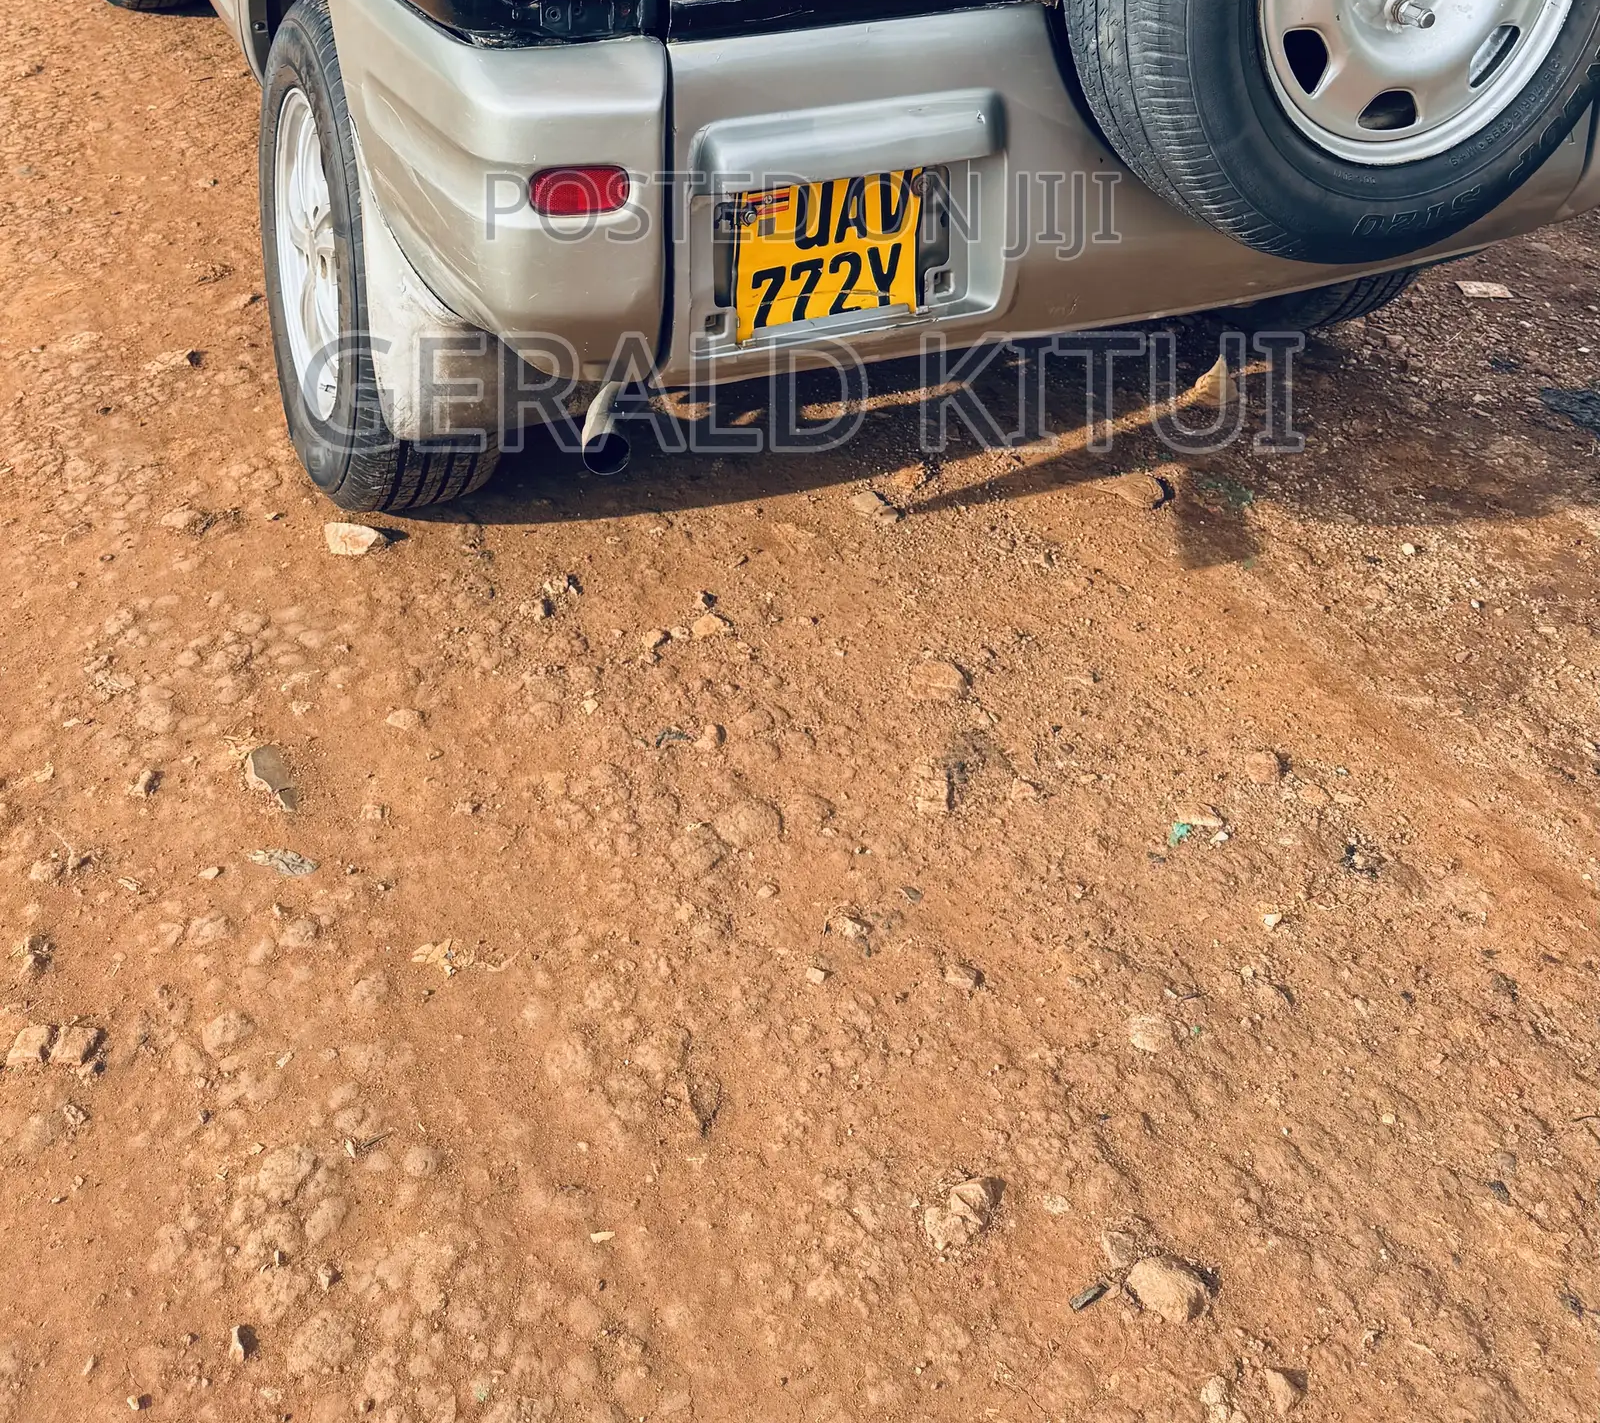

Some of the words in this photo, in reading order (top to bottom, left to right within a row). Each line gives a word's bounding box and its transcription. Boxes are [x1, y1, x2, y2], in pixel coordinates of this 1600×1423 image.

[794, 169, 914, 250] UAV
[1351, 183, 1481, 238] ST20
[751, 242, 902, 330] 772Y
